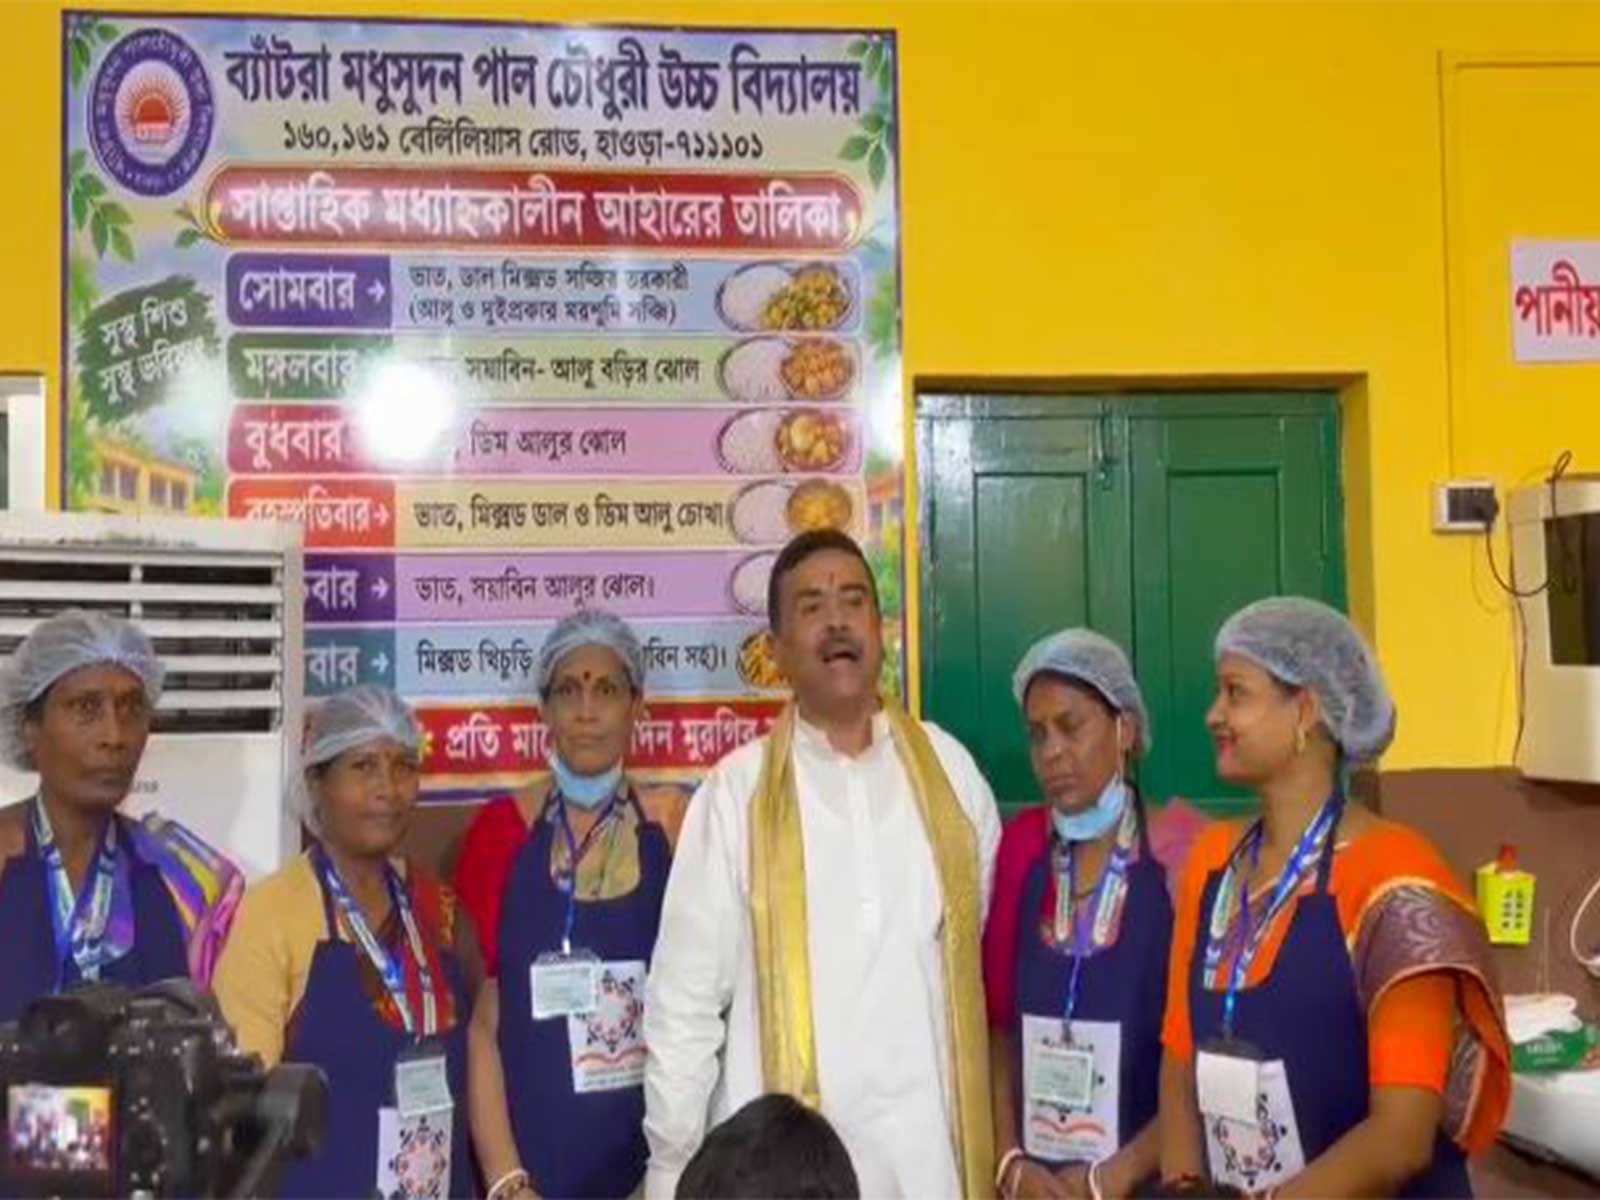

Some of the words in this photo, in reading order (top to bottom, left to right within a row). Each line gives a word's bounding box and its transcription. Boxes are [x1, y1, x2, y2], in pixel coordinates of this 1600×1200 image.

[224, 34, 331, 101] ব্যাঁটরা
[474, 47, 537, 108] পাল
[547, 37, 649, 121] চৌধুরী
[658, 46, 720, 110] উচ্চ
[729, 42, 861, 115] বিদ্যালয়
[284, 120, 390, 155] ১৬০,১৬১
[529, 126, 587, 161] রোড,
[595, 129, 763, 165] হাওড়া-৭১১১০১
[229, 171, 372, 236] সাপ্তাহিক
[595, 186, 723, 238] আহারের
[732, 181, 841, 238] তালিকা
[239, 265, 356, 310] সোমবার
[408, 266, 452, 292] ভাত,
[99, 313, 139, 356] সুস্থ
[141, 296, 188, 338] শিশু
[409, 297, 455, 326] (আলু
[461, 301, 475, 319] ও
[97, 359, 137, 404] সুস্থ
[551, 356, 596, 389] আলু
[601, 347, 649, 388] বড়ির
[655, 357, 700, 383] ঝোল
[244, 408, 344, 470] বুধবার
[517, 430, 572, 461] আলুর
[580, 429, 626, 455] ঝোল
[414, 502, 463, 533] ভাত,
[532, 502, 569, 528] ডাল
[575, 503, 589, 527] ও
[594, 493, 628, 528] ডিম
[633, 502, 675, 534] আলু
[303, 564, 360, 609] বার
[414, 576, 463, 605] ভাত,
[543, 574, 596, 609] আলুর
[303, 641, 360, 686] বার
[416, 638, 473, 675] মিক্সড
[478, 640, 534, 680] খিচুড়ি
[446, 711, 502, 761] প্রতি
